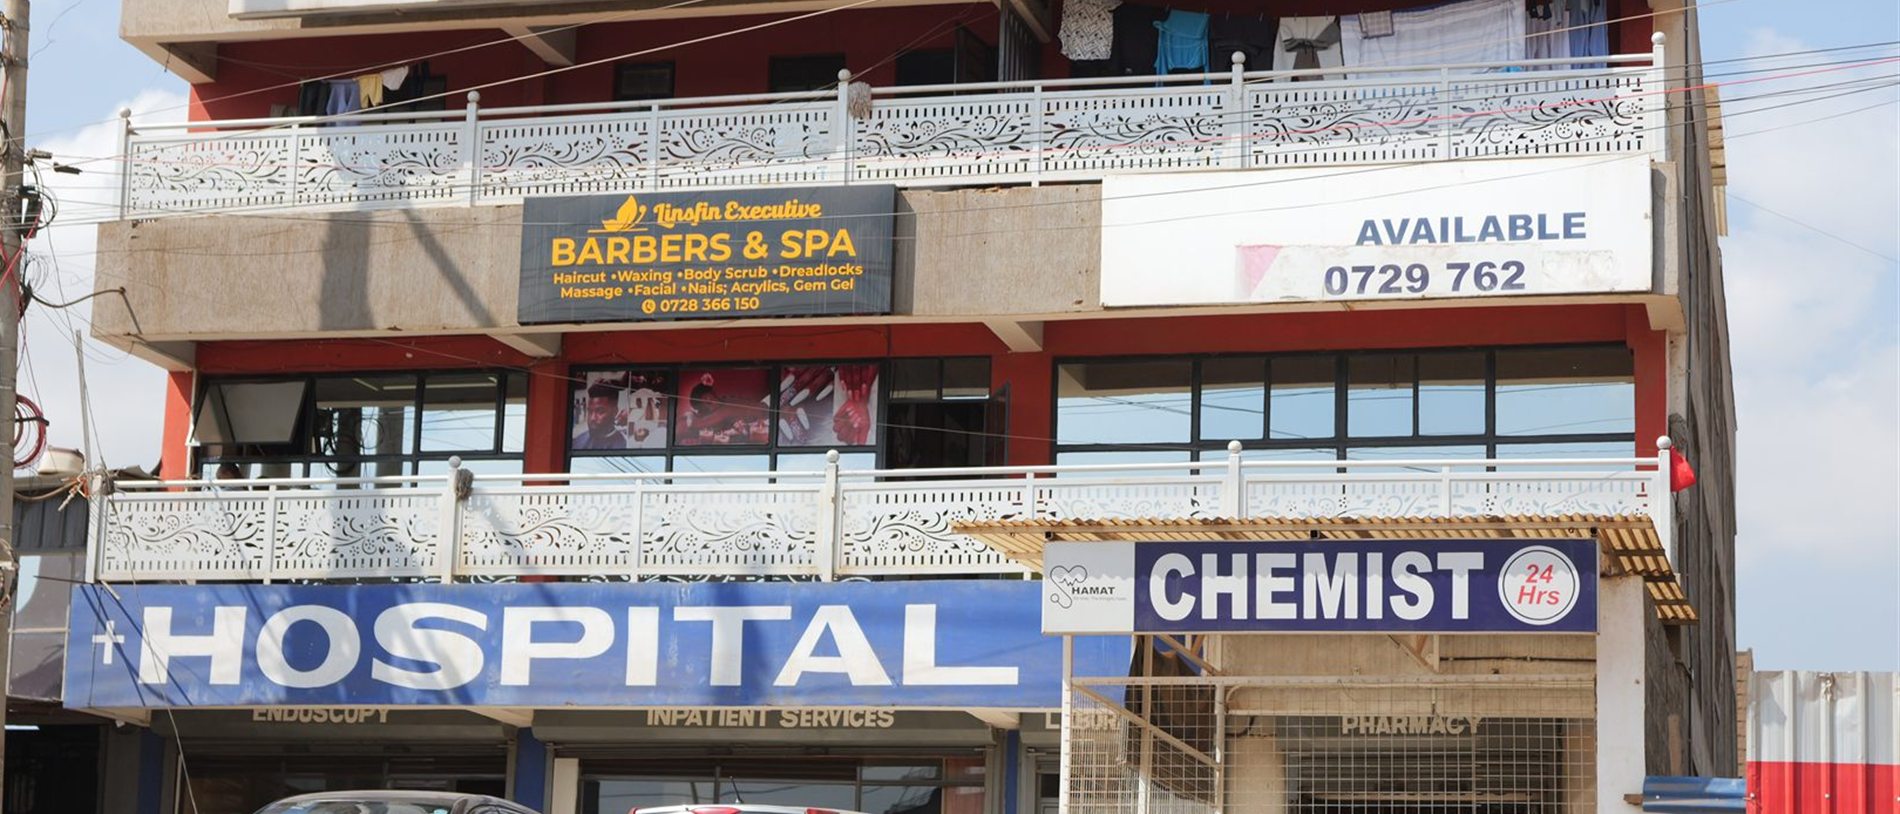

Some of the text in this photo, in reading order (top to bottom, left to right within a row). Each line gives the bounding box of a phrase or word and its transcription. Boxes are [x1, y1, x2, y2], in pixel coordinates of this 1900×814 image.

[652, 199, 822, 229] Linsfin Executive
[1355, 212, 1588, 246] AVAILABLE
[551, 228, 857, 267] BARBERS & SPA
[553, 272, 607, 284] Haircut
[725, 266, 768, 279] Scrub
[1323, 260, 1526, 296] 0729 762
[560, 286, 623, 300] Massage
[730, 279, 790, 295] Acrylics,
[793, 279, 827, 291] Gem
[830, 278, 855, 290] Gel
[660, 297, 760, 312] 0728 366 150
[1525, 564, 1554, 584] 24
[1148, 551, 1485, 623] CHEMIST
[1517, 585, 1561, 606] Hrs
[139, 602, 1019, 691] HOSPITAL
[252, 707, 390, 724] ENDOSCOPY
[646, 709, 895, 729] INPATIENT SERVICES
[1342, 715, 1483, 735] PHARMACY
